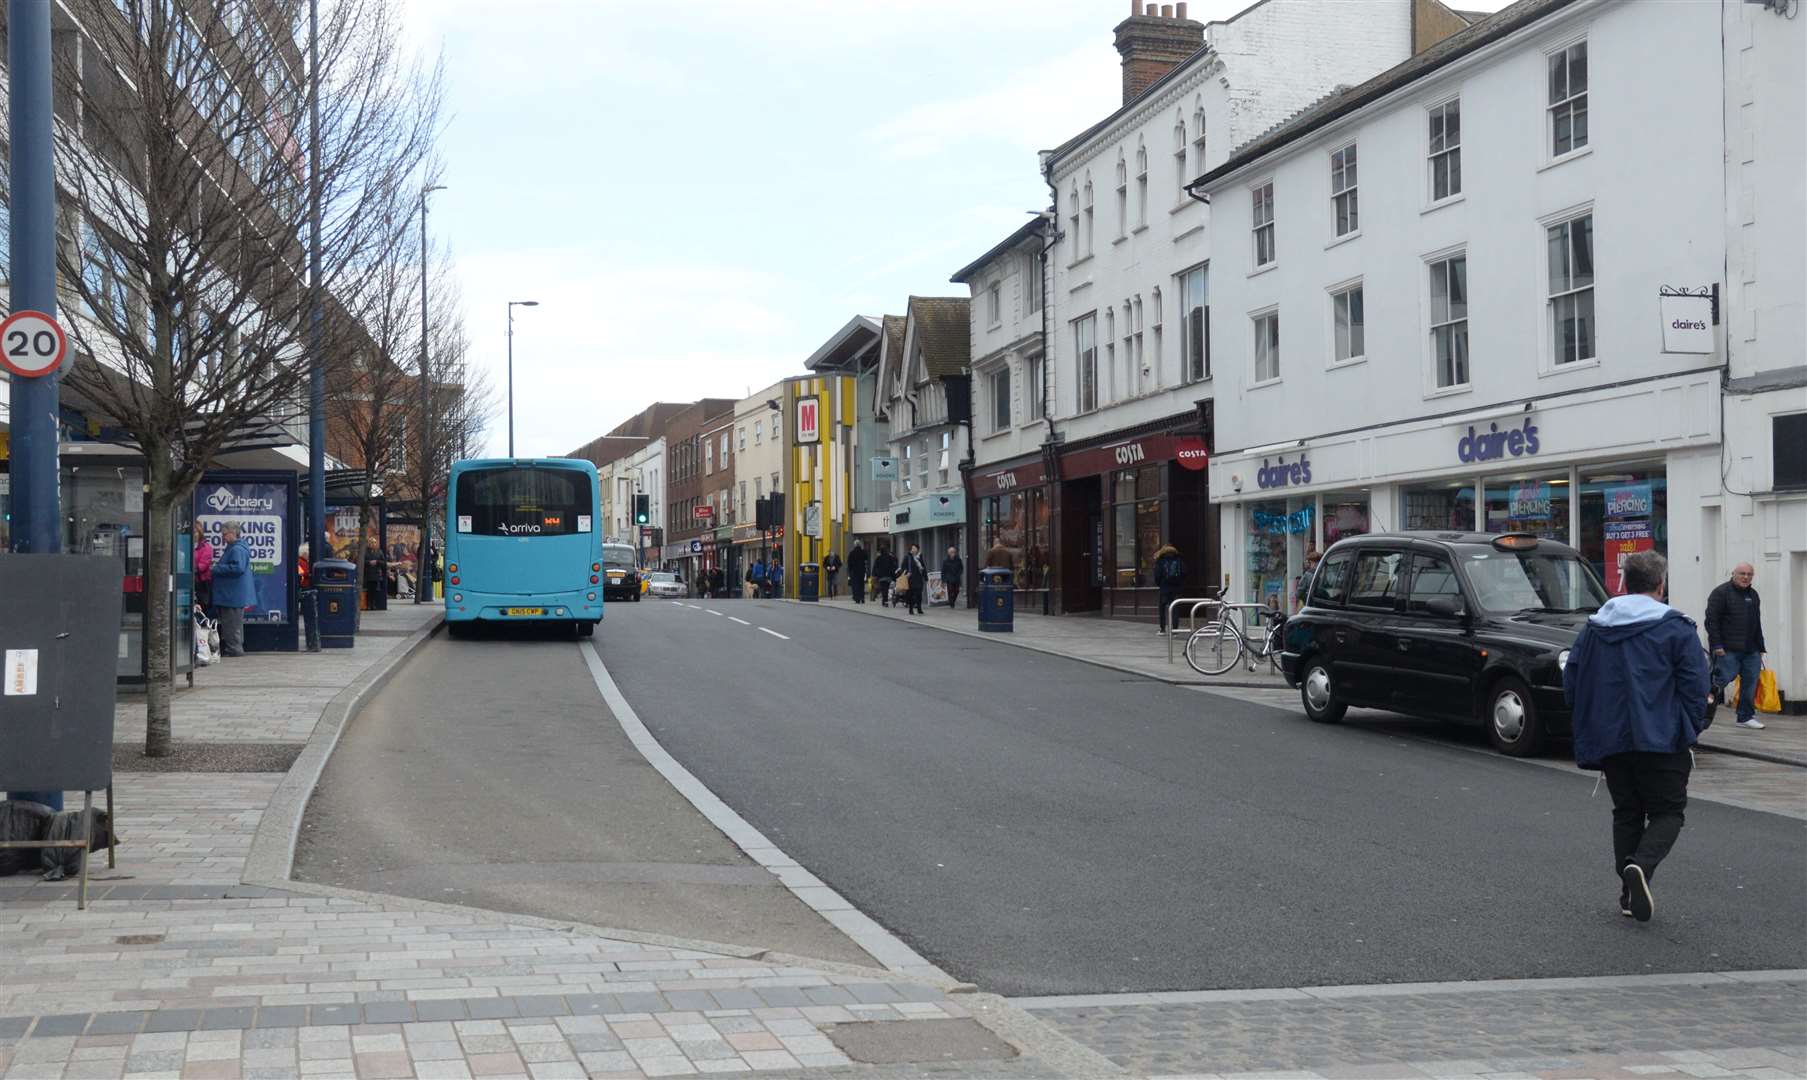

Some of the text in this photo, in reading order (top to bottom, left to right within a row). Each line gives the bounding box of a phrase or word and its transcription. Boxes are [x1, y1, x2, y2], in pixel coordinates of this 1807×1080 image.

[1672, 318, 1706, 330] claire's
[8, 330, 55, 356] 20
[801, 404, 815, 431] M
[1458, 417, 1540, 463] claire's
[1115, 443, 1145, 465] COSTA
[1178, 450, 1207, 458] COSTA
[996, 472, 1017, 489] COSTA
[1257, 453, 1312, 489] claire's
[1607, 498, 1648, 514] PIERCING
[510, 523, 541, 533] arriva
